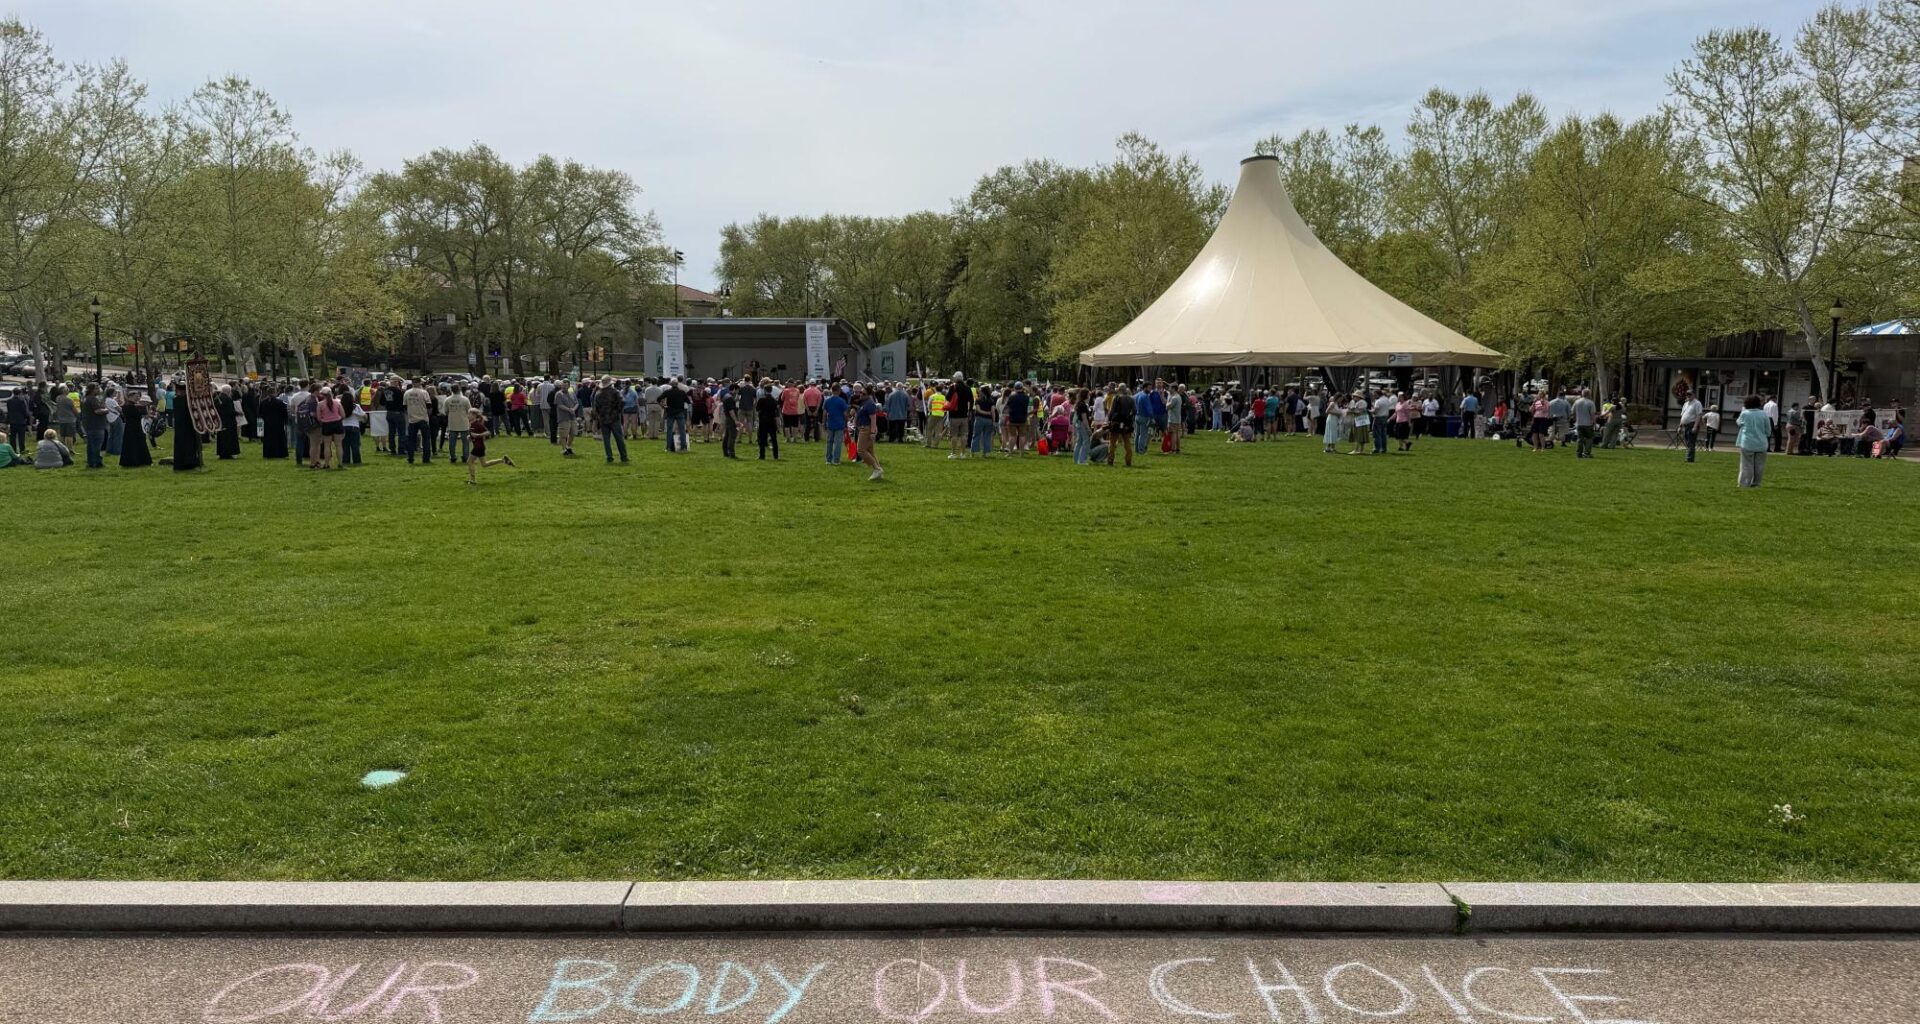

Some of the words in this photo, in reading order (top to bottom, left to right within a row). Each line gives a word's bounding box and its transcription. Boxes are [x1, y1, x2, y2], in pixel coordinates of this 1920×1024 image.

[201, 962, 479, 1024] OUR
[527, 957, 832, 1024] BODY
[873, 956, 1122, 1024] OUR
[1149, 956, 1664, 1024] CHOICE
